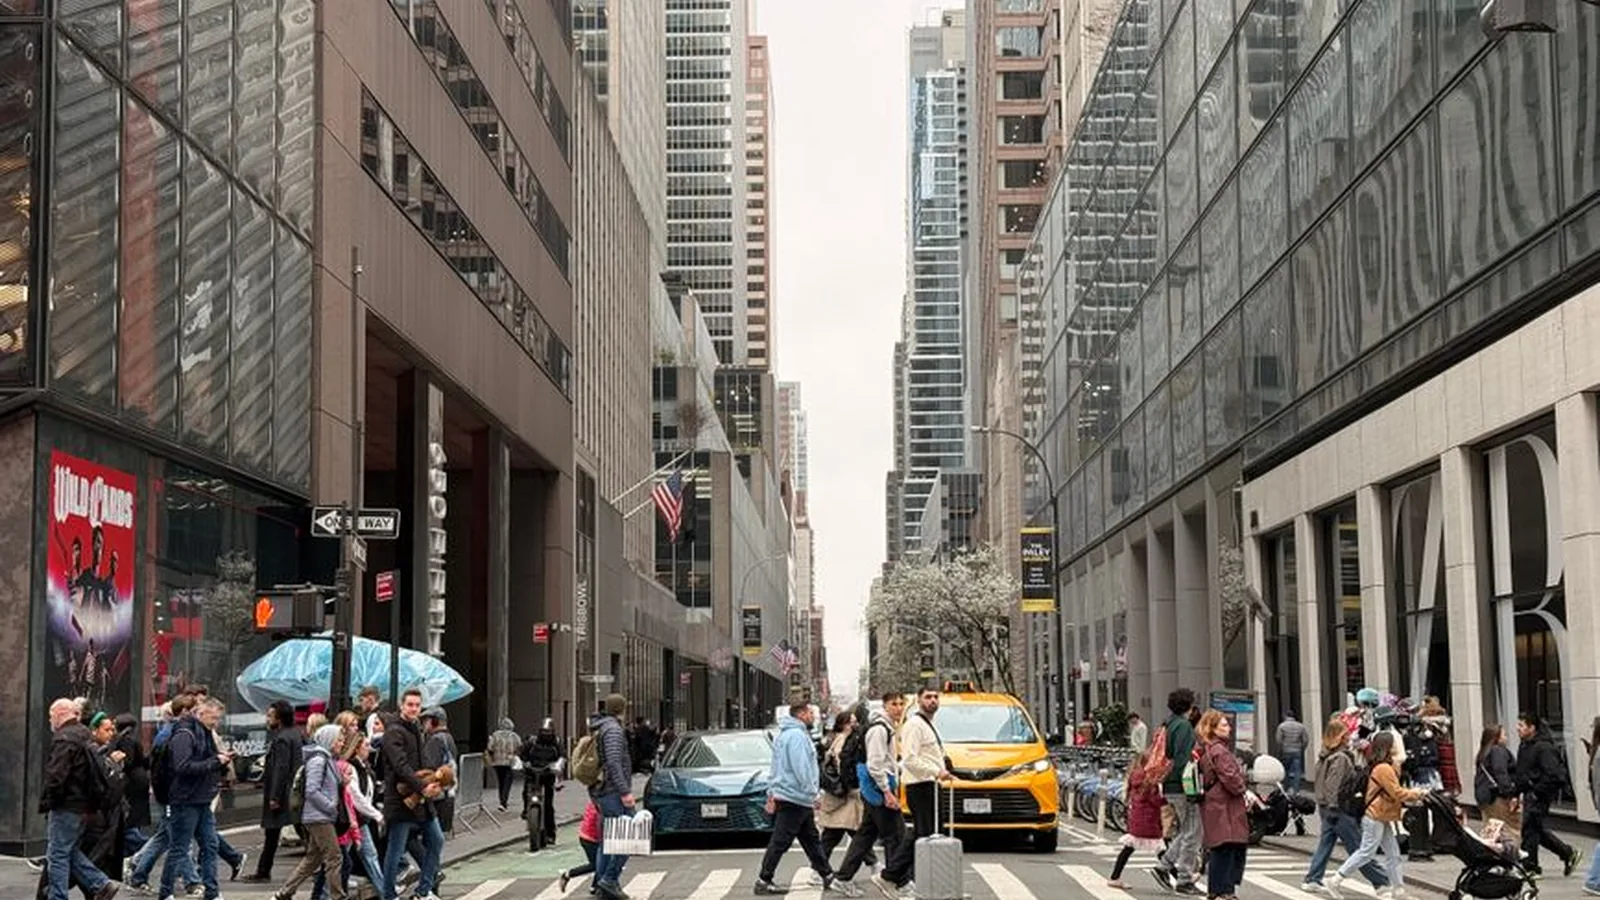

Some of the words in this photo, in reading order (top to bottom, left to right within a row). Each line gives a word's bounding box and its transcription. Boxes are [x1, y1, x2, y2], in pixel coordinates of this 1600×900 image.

[54, 464, 89, 523] WILD
[89, 475, 133, 529] CARDS
[364, 517, 391, 529] WAY
